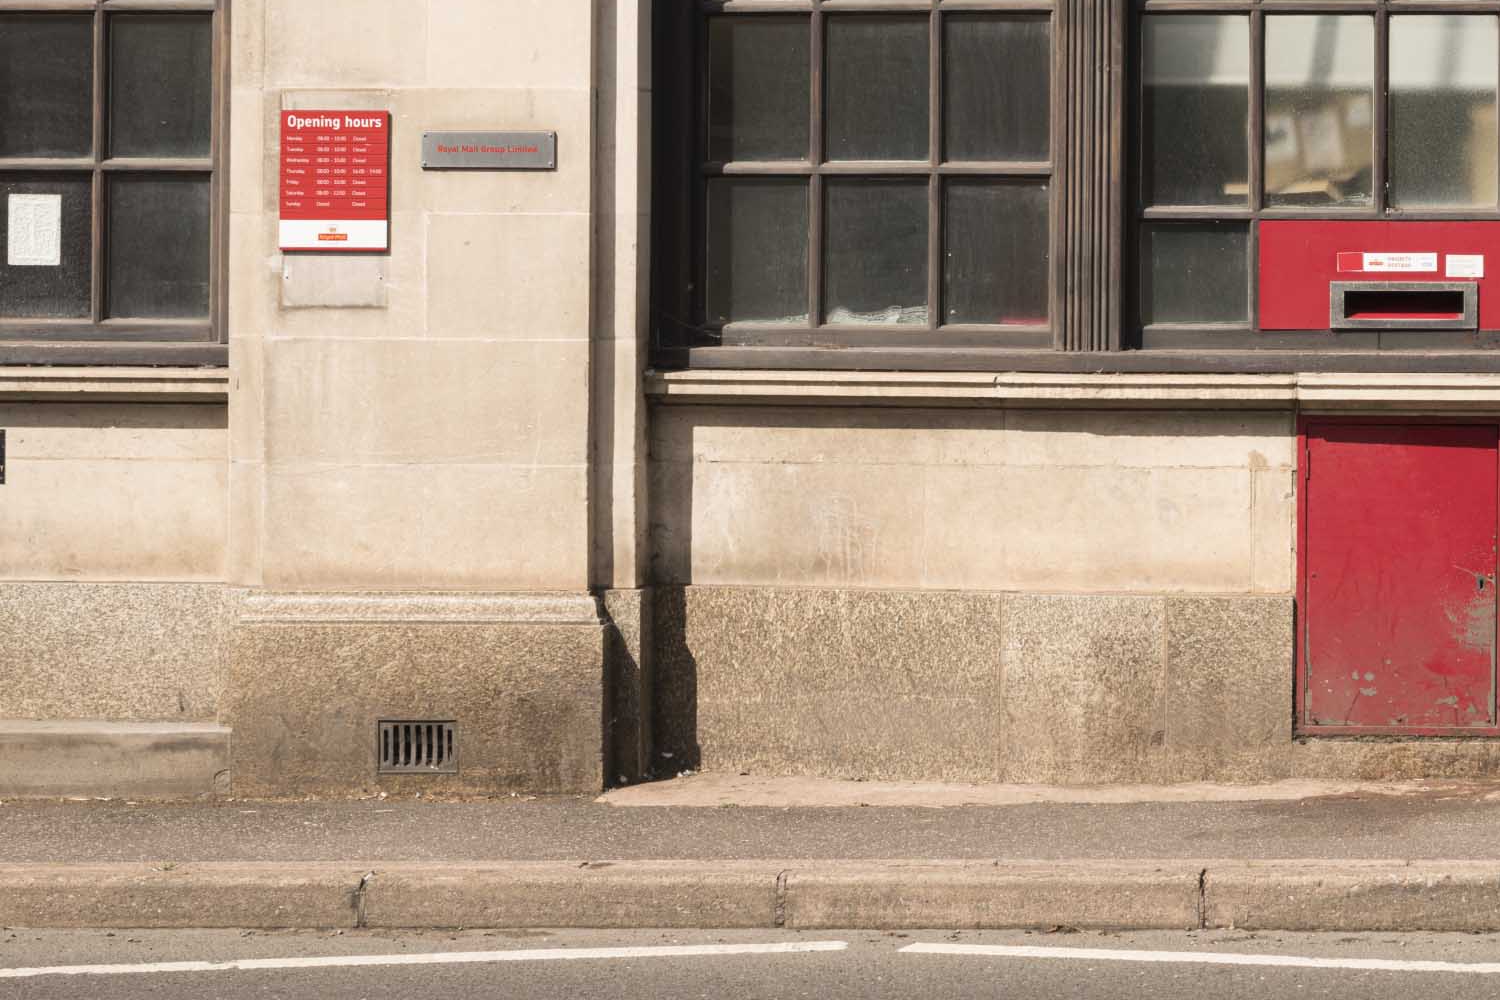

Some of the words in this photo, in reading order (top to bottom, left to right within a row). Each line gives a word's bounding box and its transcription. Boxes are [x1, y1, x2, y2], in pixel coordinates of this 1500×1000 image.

[288, 115, 340, 130] Opening
[344, 115, 383, 128] hours
[437, 144, 459, 155] Royal
[461, 144, 478, 153] Mail
[480, 144, 505, 155] Group
[507, 144, 538, 153] Limited
